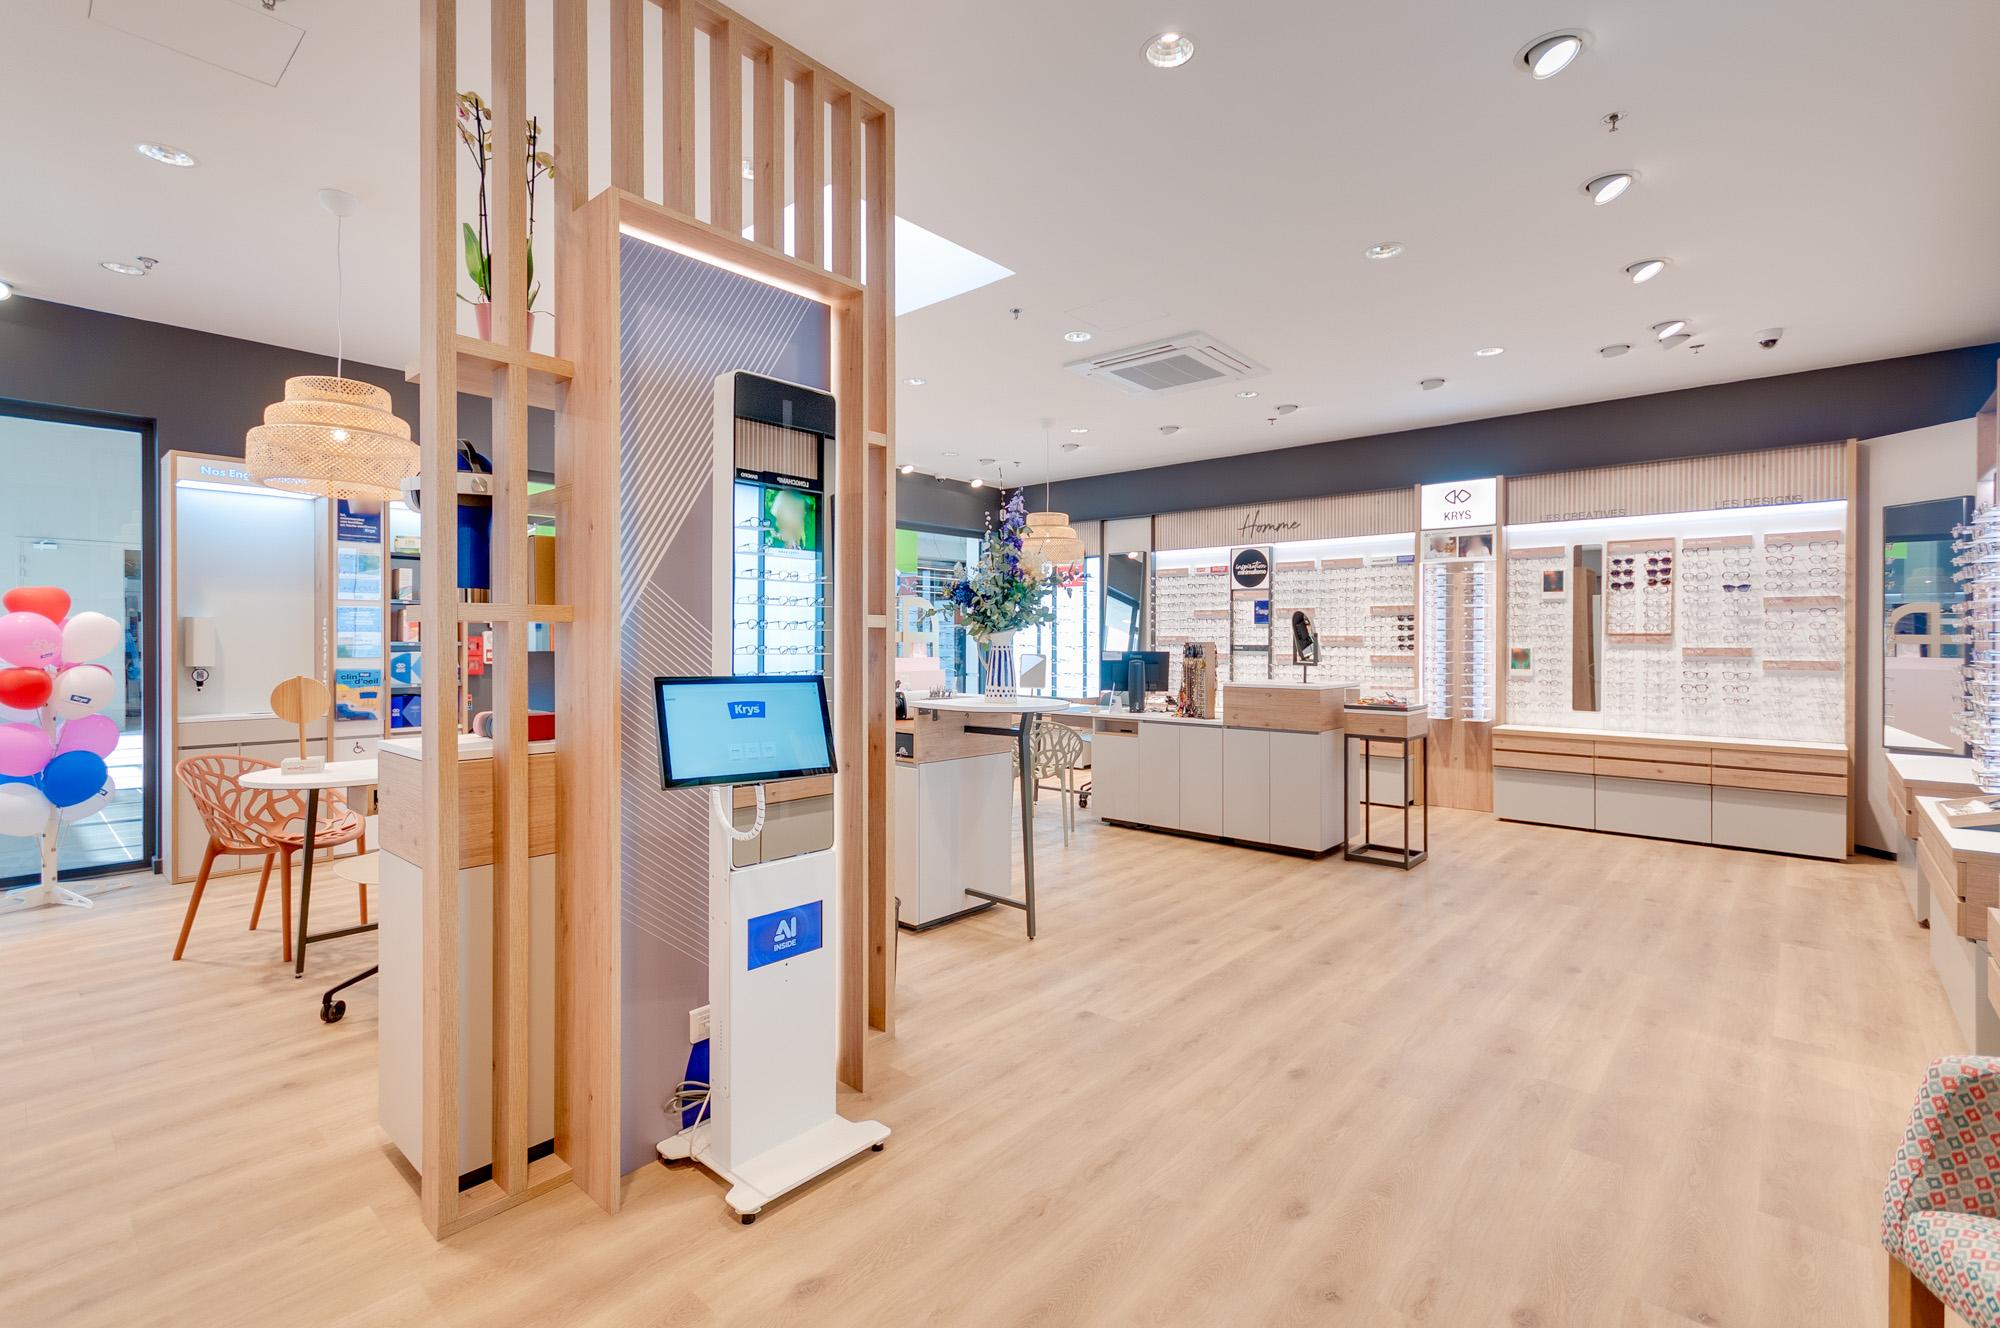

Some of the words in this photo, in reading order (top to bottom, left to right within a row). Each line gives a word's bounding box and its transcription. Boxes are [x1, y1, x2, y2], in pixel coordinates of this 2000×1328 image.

[200, 465, 226, 478] Nos
[1743, 494, 1804, 508] DESIGNS
[1444, 509, 1472, 521] KRYS
[1237, 509, 1302, 539] Homme
[734, 704, 760, 716] Krys
[774, 916, 797, 943] AI
[773, 938, 797, 952] INSIDE
